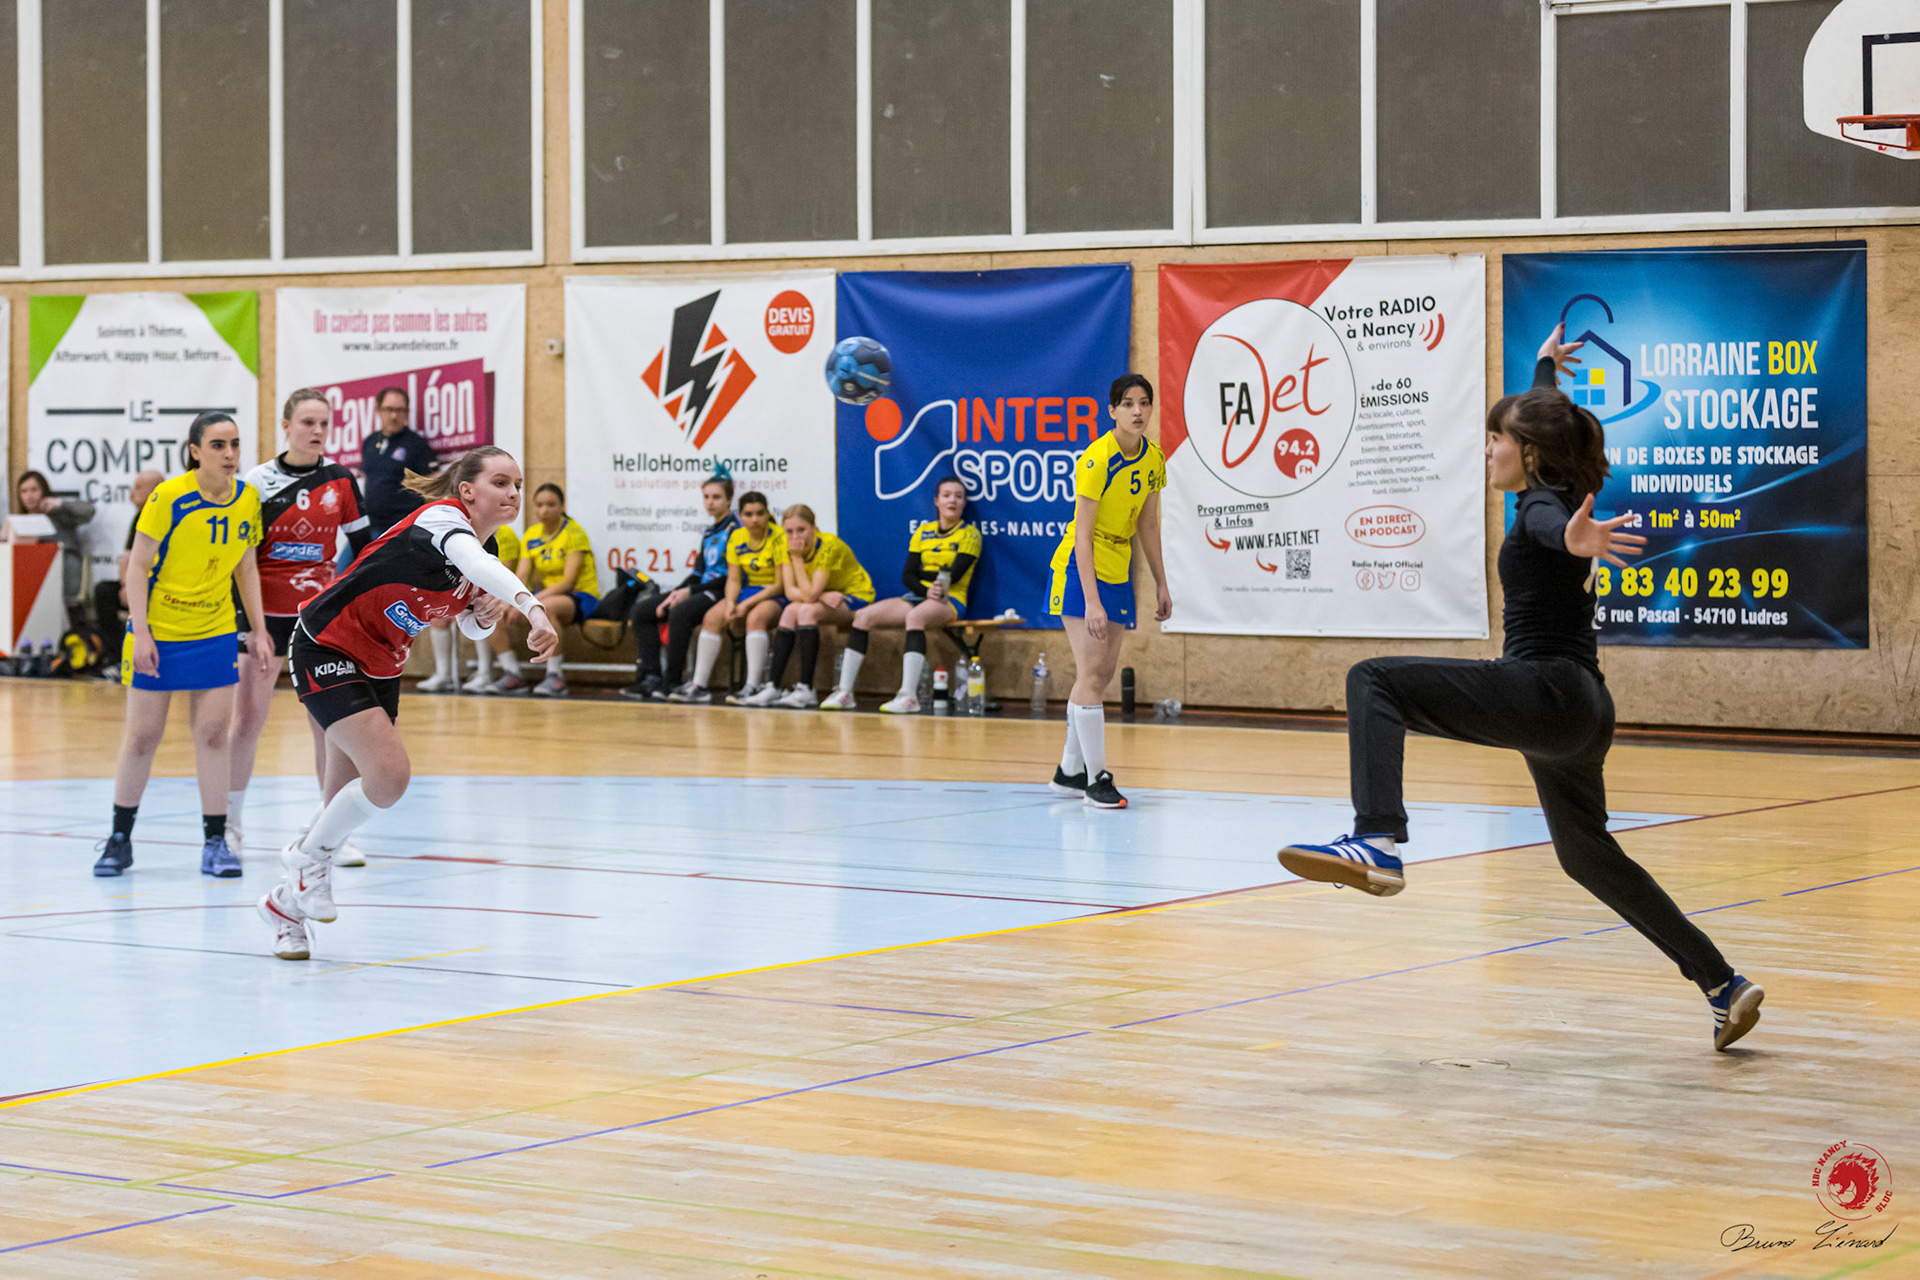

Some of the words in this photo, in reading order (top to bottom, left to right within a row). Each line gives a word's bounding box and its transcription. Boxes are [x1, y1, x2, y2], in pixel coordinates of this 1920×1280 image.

[768, 308, 811, 324] DEVIS
[1324, 305, 1373, 322] Votre
[1379, 296, 1436, 316] RADIO
[314, 310, 327, 334] Un
[332, 310, 368, 333] caviste
[372, 314, 390, 336] pas
[394, 314, 431, 332] comme
[434, 308, 450, 332] les
[454, 308, 488, 332] autres
[768, 324, 810, 336] GRATUIT
[1347, 324, 1356, 338] à
[1363, 322, 1416, 338] Nancy
[342, 340, 460, 352] www.lacavedeleon.fr
[1357, 342, 1364, 352] &
[1369, 340, 1412, 350] environs
[114, 352, 148, 363] Happy
[152, 350, 180, 362] Hour,
[1640, 342, 1760, 376] LORRAINE
[1768, 340, 1818, 374] BOX
[1396, 378, 1412, 390] 60
[1360, 392, 1428, 408] ÉMISSIONS
[1664, 388, 1818, 430] STOCKAGE
[130, 400, 154, 422] LE
[325, 386, 381, 454] Cav
[408, 370, 476, 438] Léon
[958, 397, 1098, 442] INTER
[47, 439, 191, 473] COMPT
[1277, 440, 1314, 456] 94.2
[1628, 446, 1648, 464] DE
[1653, 446, 1705, 465] BOXES
[1710, 446, 1732, 464] DE
[1738, 446, 1818, 464] STOCKAGE
[953, 449, 1084, 502] SPOR
[1299, 466, 1312, 474] FM
[86, 480, 131, 503] Cam
[630, 478, 679, 489] solution
[750, 480, 787, 492] projet
[1130, 470, 1142, 495] 5
[1631, 474, 1732, 493] INDIVIDUELS
[296, 489, 310, 510] 6
[1197, 502, 1270, 516] Programmes
[607, 522, 616, 531] et
[1215, 518, 1222, 528] &
[1226, 516, 1254, 527] Infos
[1360, 517, 1372, 526] EN
[1376, 514, 1412, 524] DIRECT
[1624, 509, 1642, 528] de
[1684, 510, 1694, 528] à
[206, 515, 228, 544] 11
[1354, 529, 1366, 538] EN
[1370, 525, 1416, 536] PODCAST
[1235, 529, 1319, 550] WWW.FAJET.NET
[608, 548, 637, 571] 06
[647, 548, 674, 572] 21
[686, 549, 698, 568] 4
[1352, 560, 1372, 568] Radio
[1374, 560, 1392, 570] Fajet
[1395, 560, 1423, 568] Officiel
[1598, 566, 1612, 596] 3
[1621, 567, 1654, 596] 83
[1664, 568, 1698, 598] 40
[1708, 568, 1741, 598] 23
[1752, 568, 1788, 598] 99
[1610, 609, 1634, 622] rue
[1638, 606, 1680, 624] Pascal
[1694, 608, 1736, 624] 54710
[1741, 608, 1788, 625] Ludres
